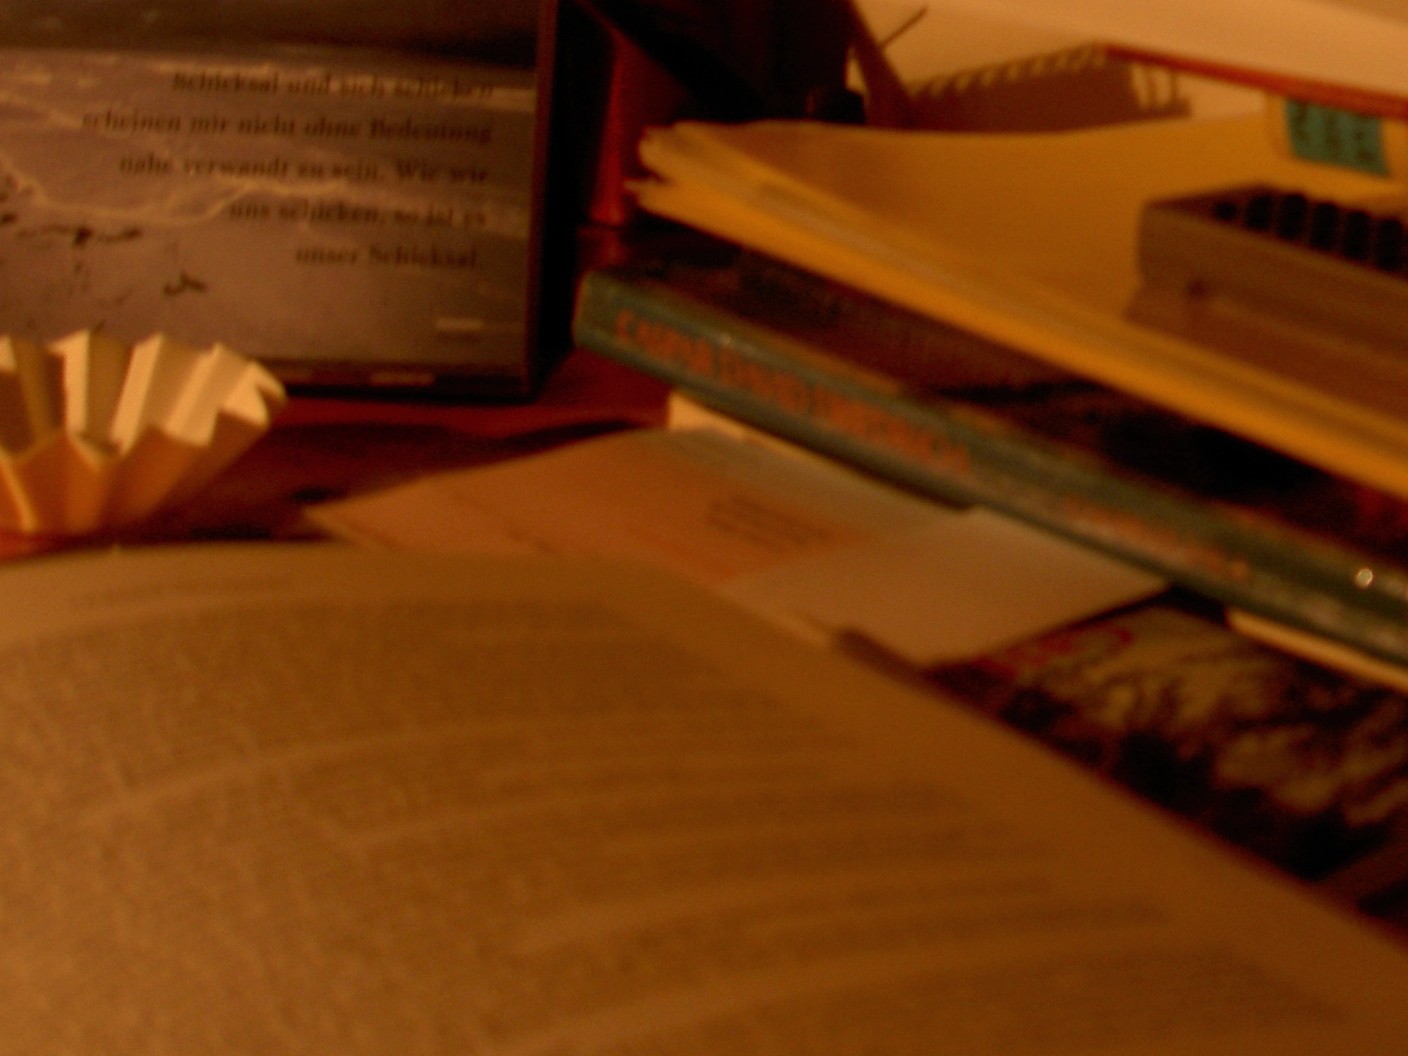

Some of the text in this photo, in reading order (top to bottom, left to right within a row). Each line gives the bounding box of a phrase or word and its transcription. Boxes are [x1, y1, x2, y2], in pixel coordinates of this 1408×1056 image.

[288, 71, 330, 94] und
[82, 110, 492, 144] scheinen mir nicht ohne Bedeutung
[119, 153, 170, 175] nahe
[182, 156, 288, 177] verwandt
[297, 161, 325, 178] zu
[396, 158, 439, 181] Wie
[450, 164, 488, 183] wir
[229, 202, 270, 220] uns
[394, 207, 419, 225] so
[425, 205, 455, 227] ist
[295, 246, 359, 265] unser
